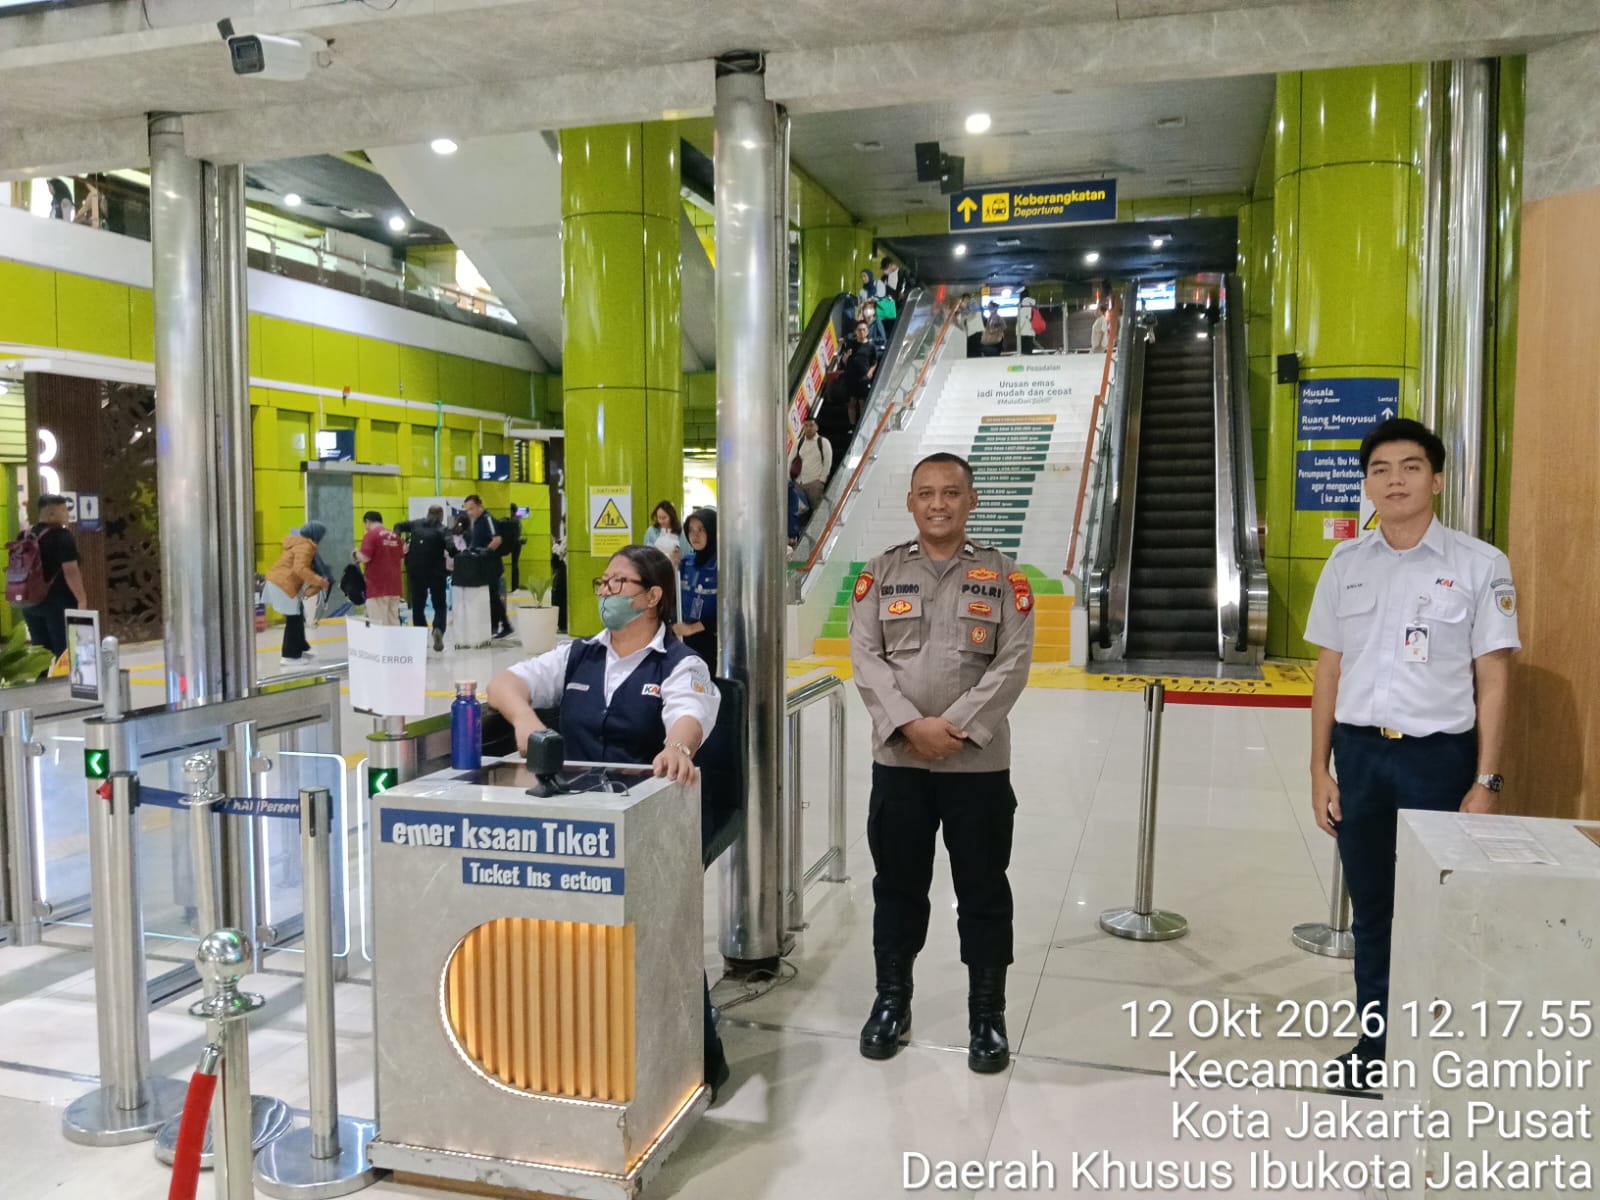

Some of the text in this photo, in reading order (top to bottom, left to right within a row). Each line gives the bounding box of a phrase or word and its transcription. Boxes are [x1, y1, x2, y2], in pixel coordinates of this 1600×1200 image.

[1013, 190, 1106, 207] Keberangkatan
[1013, 205, 1064, 217] Departures
[1000, 380, 1029, 388] Urusan
[995, 389, 1025, 397] mudah
[1028, 388, 1044, 396] dan
[1047, 388, 1072, 396] cepat
[1303, 388, 1334, 397] Musala
[1301, 414, 1376, 427] Ruang Menyusui
[1298, 469, 1331, 480] Penumpang
[1435, 578, 1454, 588] KAI
[962, 584, 1002, 598] POLRI
[381, 655, 414, 664] ERROR
[233, 800, 254, 811] KAI
[462, 818, 537, 852] ksaan
[542, 822, 609, 857] Tiket
[470, 862, 612, 893] Ticket Ins ection
